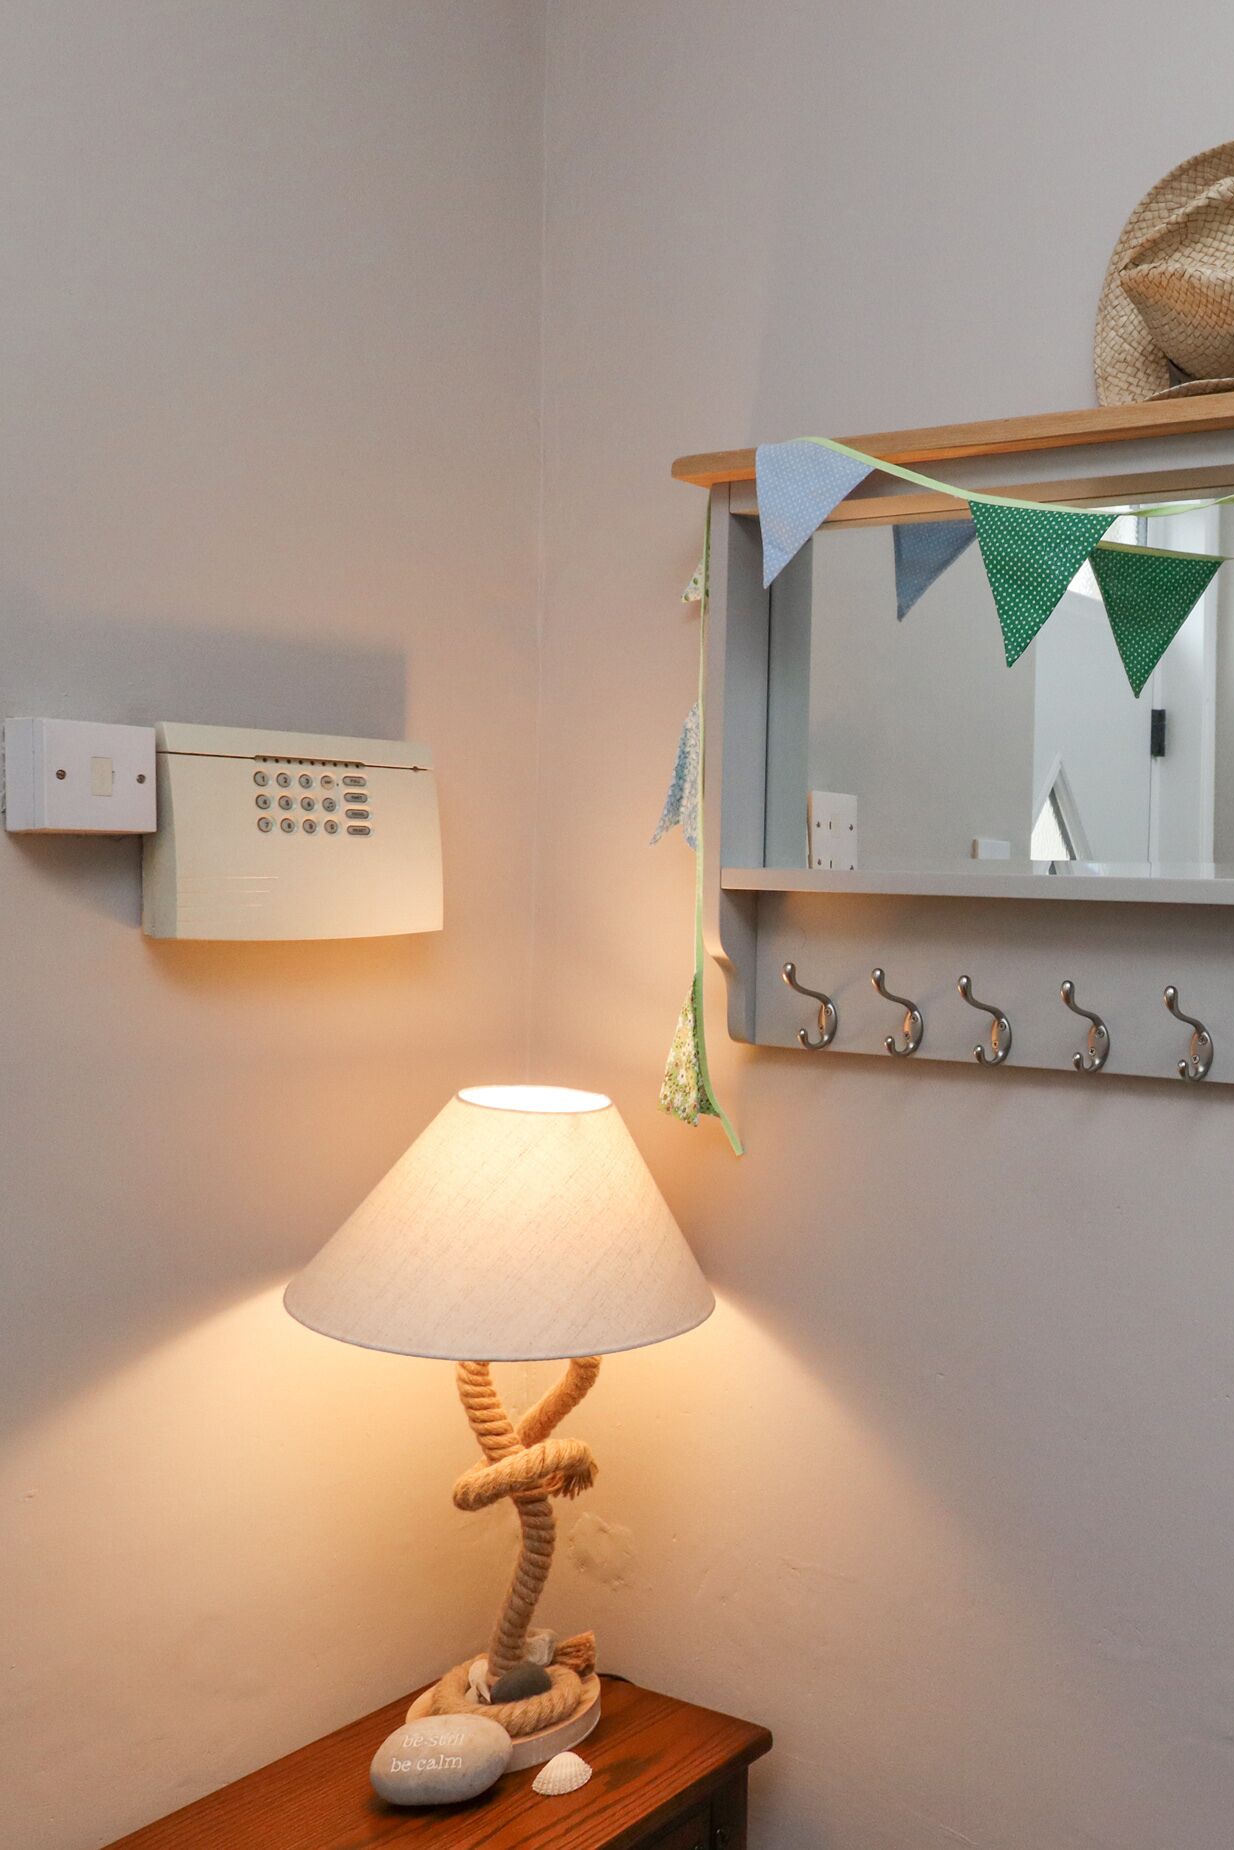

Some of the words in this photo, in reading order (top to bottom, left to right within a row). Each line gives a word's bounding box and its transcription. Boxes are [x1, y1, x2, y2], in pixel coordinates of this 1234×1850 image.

[403, 1735, 424, 1747] be
[391, 1757, 412, 1773] be
[416, 1754, 463, 1771] calm
